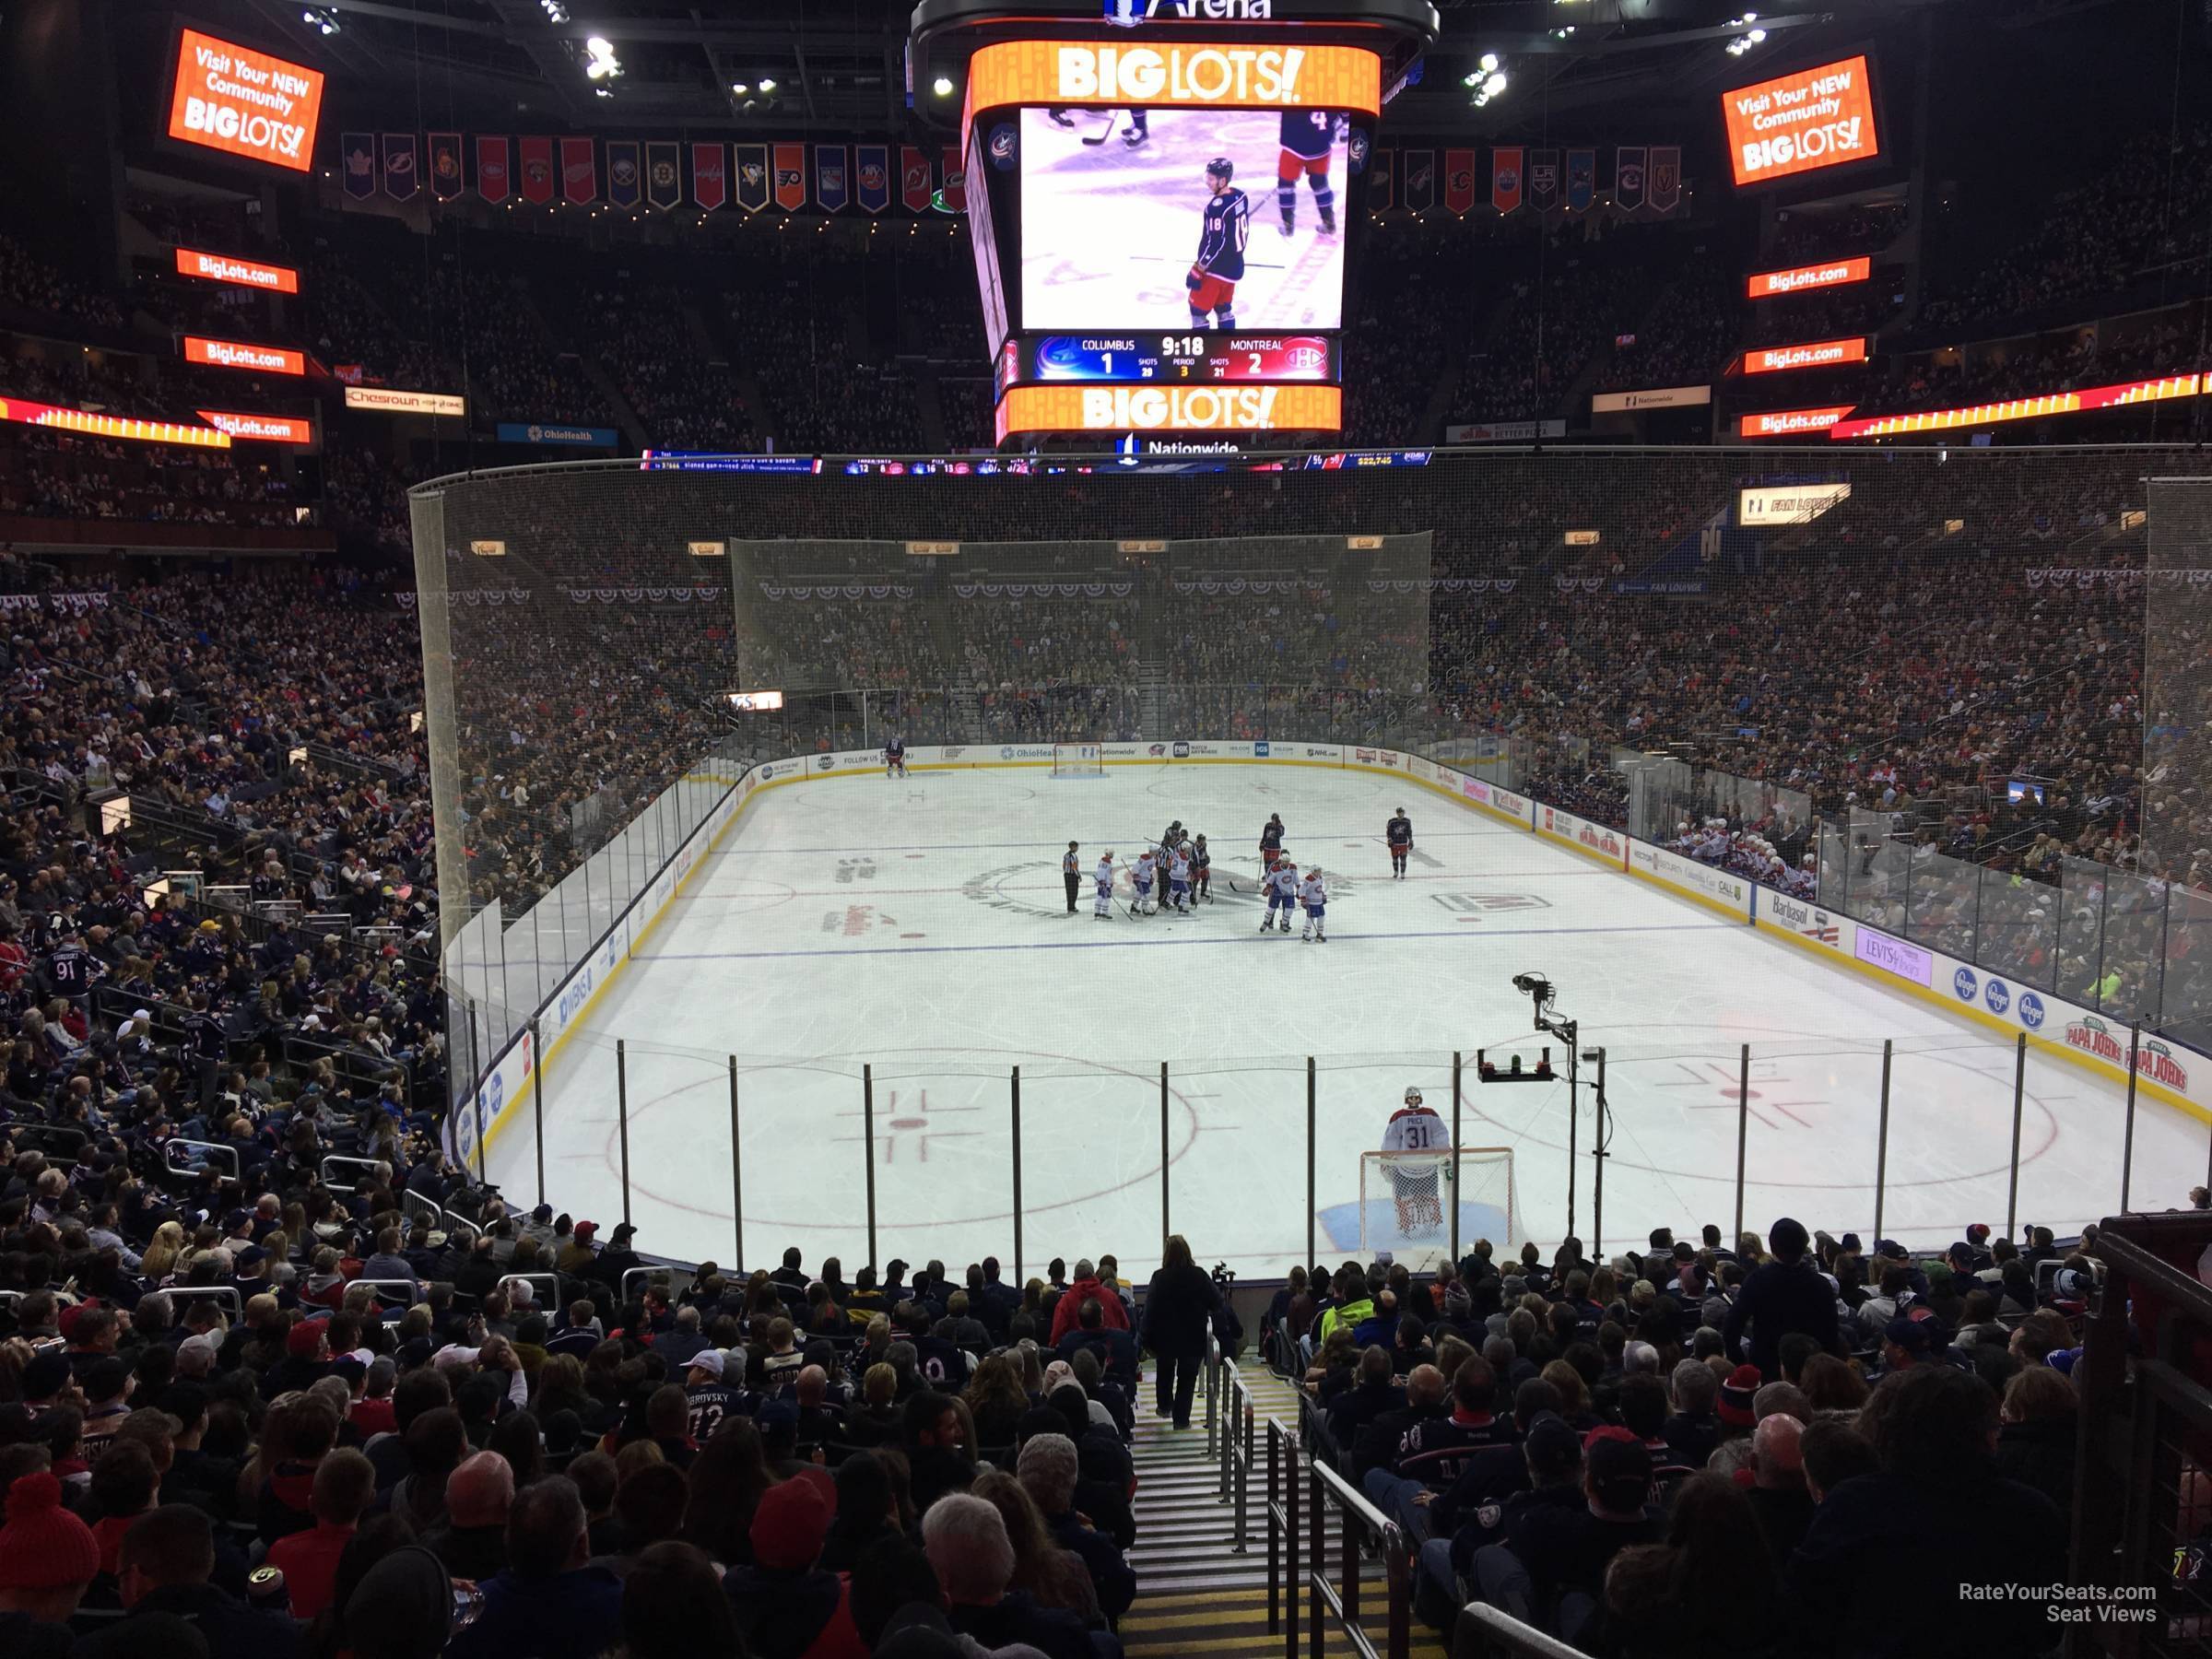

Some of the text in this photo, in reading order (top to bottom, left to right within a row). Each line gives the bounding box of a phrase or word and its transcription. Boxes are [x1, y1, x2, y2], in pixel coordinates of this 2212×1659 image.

[195, 46, 309, 98] Visit Your NEW
[206, 73, 293, 117] Community
[1736, 72, 1851, 115] Visit Your NEW
[1753, 98, 1841, 130] Community
[1208, 218, 1222, 230] 18
[199, 257, 277, 285] BigLots.com
[1769, 267, 1847, 290] BigLots.com
[1082, 340, 1135, 351] COLUMBUS
[1162, 336, 1204, 355] 9:18
[1230, 340, 1283, 351] MONTREAL
[206, 344, 285, 367] BigLots.com
[1101, 353, 1112, 373] 1
[1172, 358, 1195, 366] PERIOD
[1249, 353, 1261, 373] 2
[1764, 347, 1842, 367] BigLots.com
[1142, 367, 1153, 377] 29
[1181, 366, 1188, 377] 3
[1214, 368, 1225, 377] 21
[349, 391, 419, 406] Chesrown
[1638, 395, 1673, 405] Nationwide
[214, 416, 290, 437] BigLots.com
[1525, 428, 1548, 437] PIZA
[1761, 414, 1839, 432] BigLots.com
[544, 429, 592, 441] OhioHealth
[1149, 441, 1238, 454] Nationwide
[1771, 499, 1795, 512] FAN
[1651, 583, 1666, 592] FAN
[1669, 582, 1701, 592] LOUNGE
[1256, 745, 1268, 754] IGS
[844, 756, 868, 764] FOLLOW
[1718, 880, 1733, 895] CALL
[1773, 894, 1807, 924] Barbasol
[1866, 938, 1894, 964] LEVI'S
[56, 960, 75, 981] 91
[1956, 971, 1976, 997] Kroger
[1987, 982, 2009, 1011] Kroger
[2021, 995, 2043, 1025] Kroger
[2087, 1017, 2104, 1031] PIZZA
[2067, 1028, 2122, 1062] PAPA JOHNS
[2150, 1041, 2167, 1053] PIZZA
[2125, 1050, 2186, 1089] PPA JOHNS
[1407, 1126, 1429, 1148] 31
[689, 1393, 728, 1406] BROVSKY
[688, 1405, 724, 1438] 72
